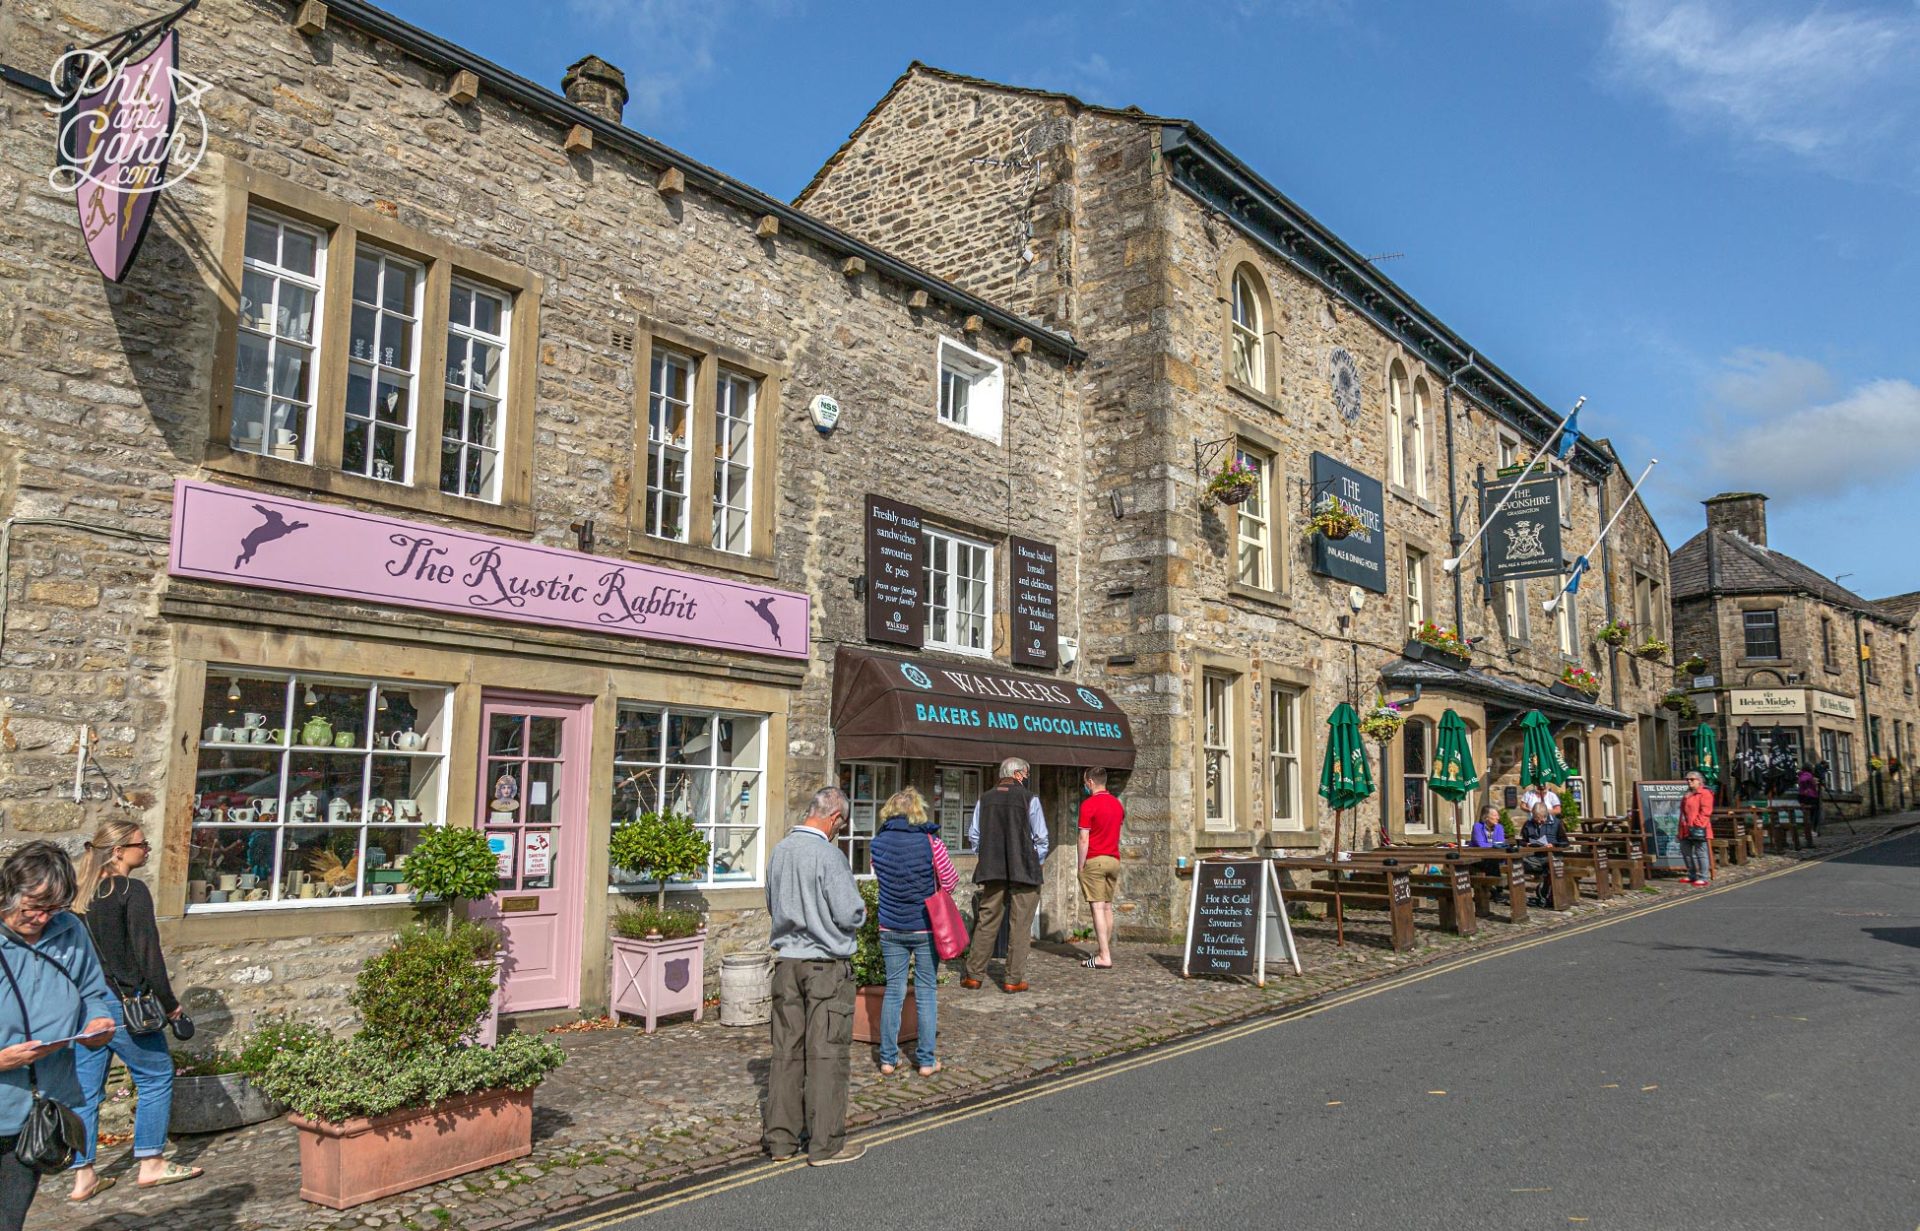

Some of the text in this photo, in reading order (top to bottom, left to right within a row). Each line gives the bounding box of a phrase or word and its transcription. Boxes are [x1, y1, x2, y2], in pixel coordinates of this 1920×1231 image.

[820, 401, 838, 413] NSS
[1342, 477, 1361, 501] THE
[1513, 488, 1531, 499] THE
[1495, 495, 1551, 512] EVONSHIRE
[872, 505, 920, 529] Freshly made
[876, 527, 917, 545] sandwiches
[880, 545, 913, 561] savouries
[1018, 545, 1053, 563] Home baked
[884, 562, 909, 579] & pies
[385, 533, 698, 625] The Rustic Rabbit
[1018, 577, 1054, 592] and delicious
[1020, 591, 1052, 606] cakes from
[1018, 603, 1055, 620] the Yorkshire
[1029, 620, 1045, 633] Dales
[941, 670, 1071, 705] WALKERS
[1739, 697, 1764, 706] Helen
[915, 703, 1122, 739] BAKERS AND CHOCOLATIERS
[1643, 784, 1656, 792] THE
[1205, 894, 1251, 904] Hot & Cold
[1200, 905, 1253, 916] Sandwiches &
[1208, 917, 1243, 928] Savouries
[1196, 944, 1249, 957] & Homemade
[1211, 957, 1231, 970] Soup
